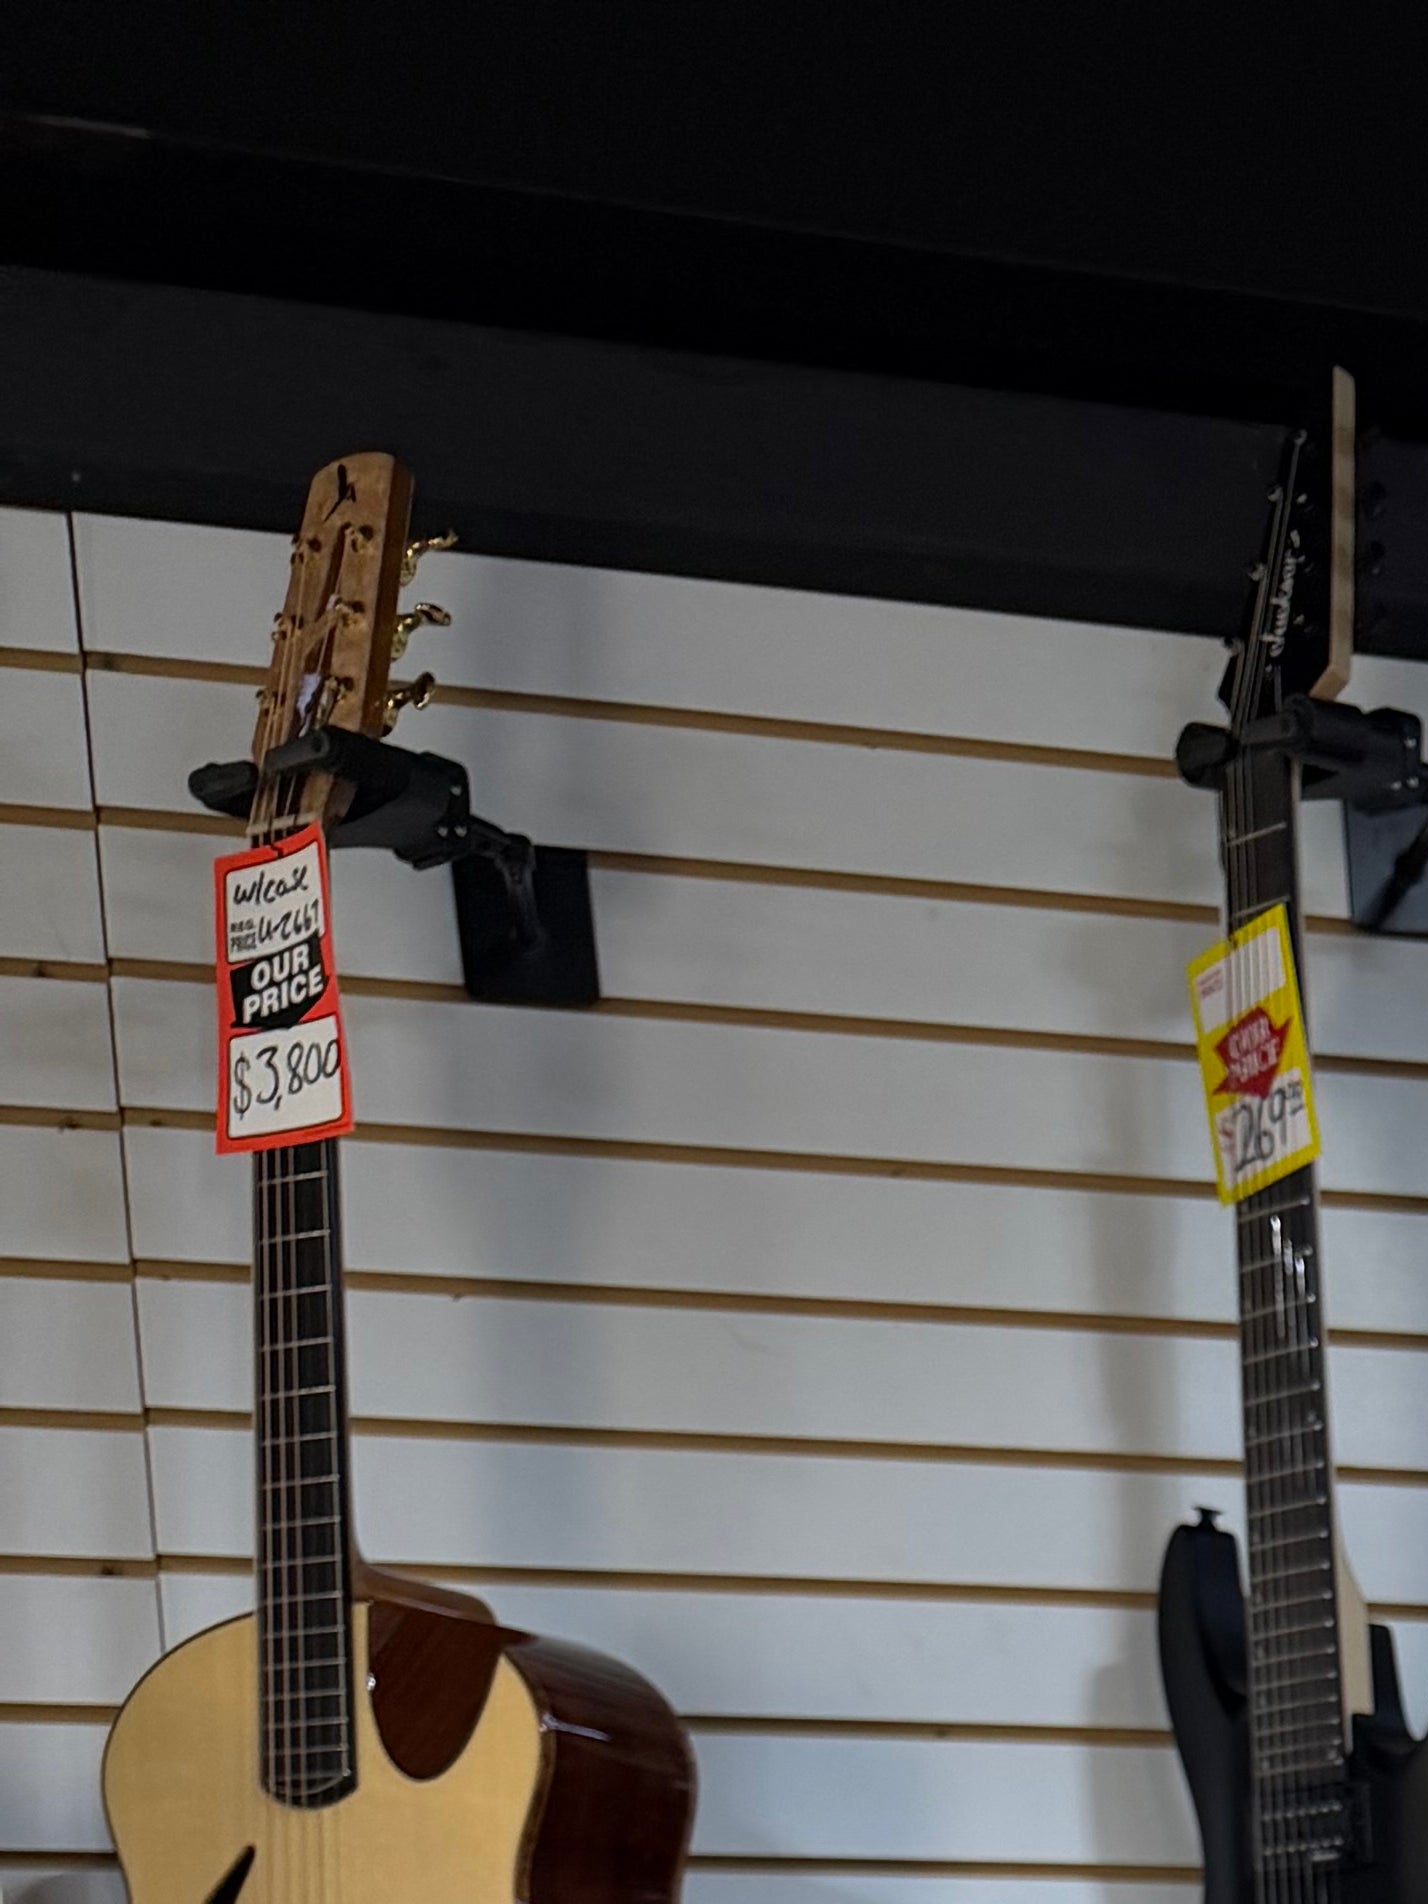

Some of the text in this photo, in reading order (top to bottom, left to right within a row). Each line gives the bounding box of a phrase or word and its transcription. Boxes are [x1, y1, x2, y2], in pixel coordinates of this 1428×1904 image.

[241, 967, 325, 1025] PRICE
[250, 943, 310, 991] OUR
[232, 1038, 341, 1119] $3,800
